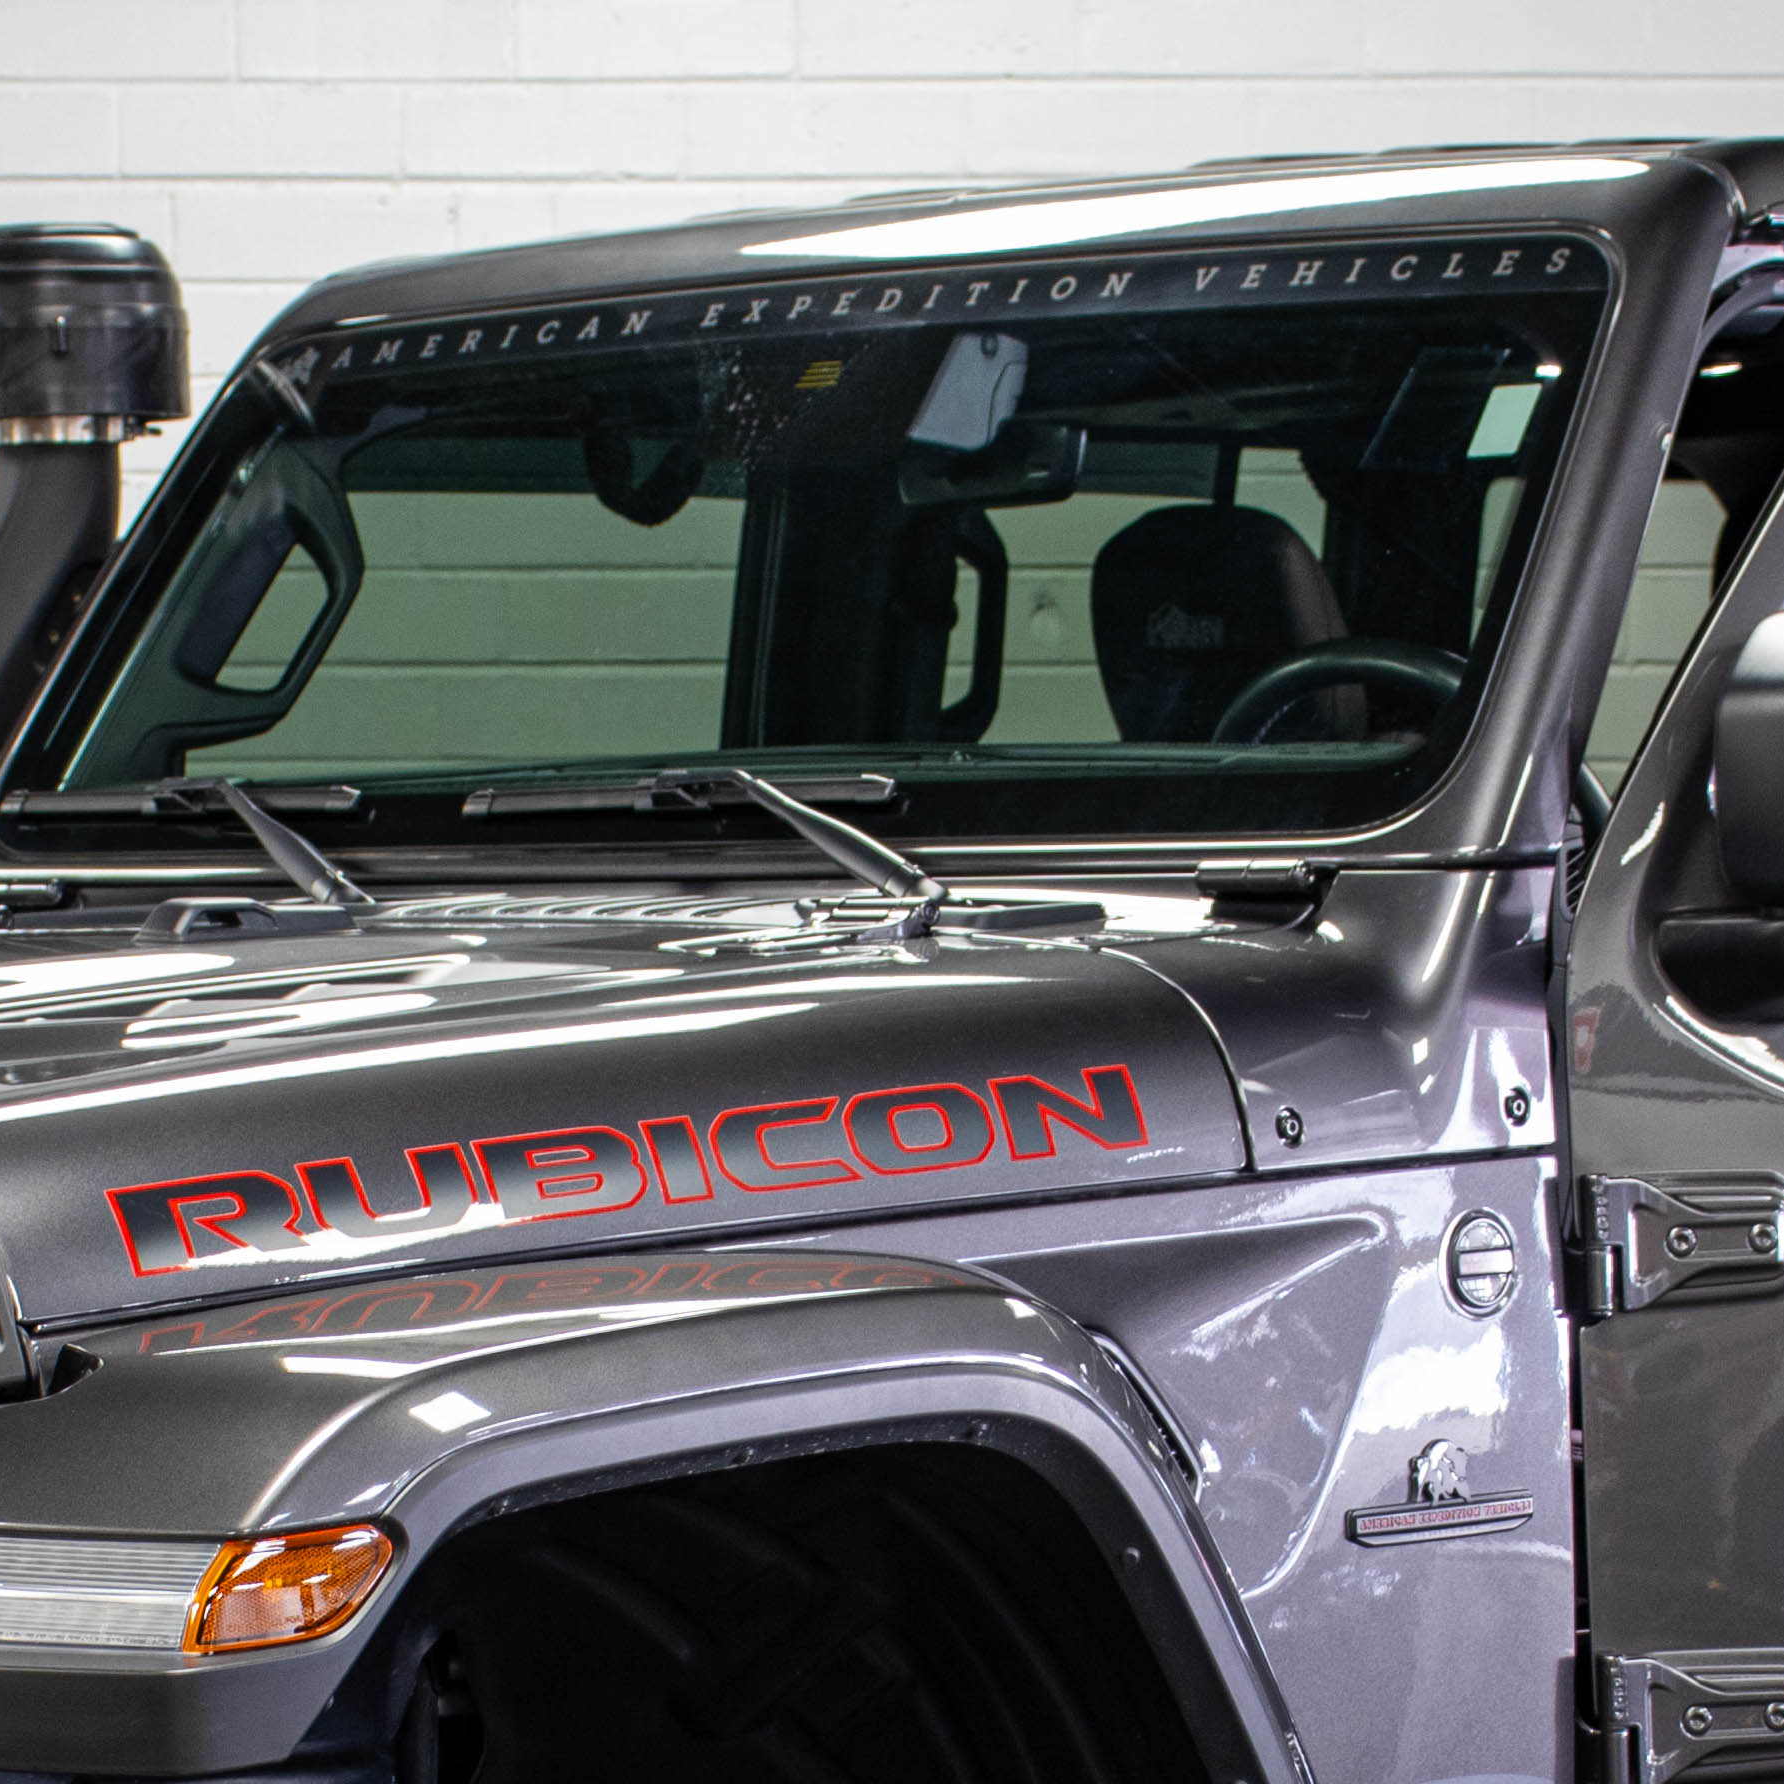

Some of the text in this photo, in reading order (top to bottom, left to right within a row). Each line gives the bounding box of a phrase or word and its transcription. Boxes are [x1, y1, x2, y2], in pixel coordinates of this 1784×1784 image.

[328, 246, 1575, 371] AMERICAN EXPEDITION VEHICLES
[105, 1063, 1148, 1279] RUBICON
